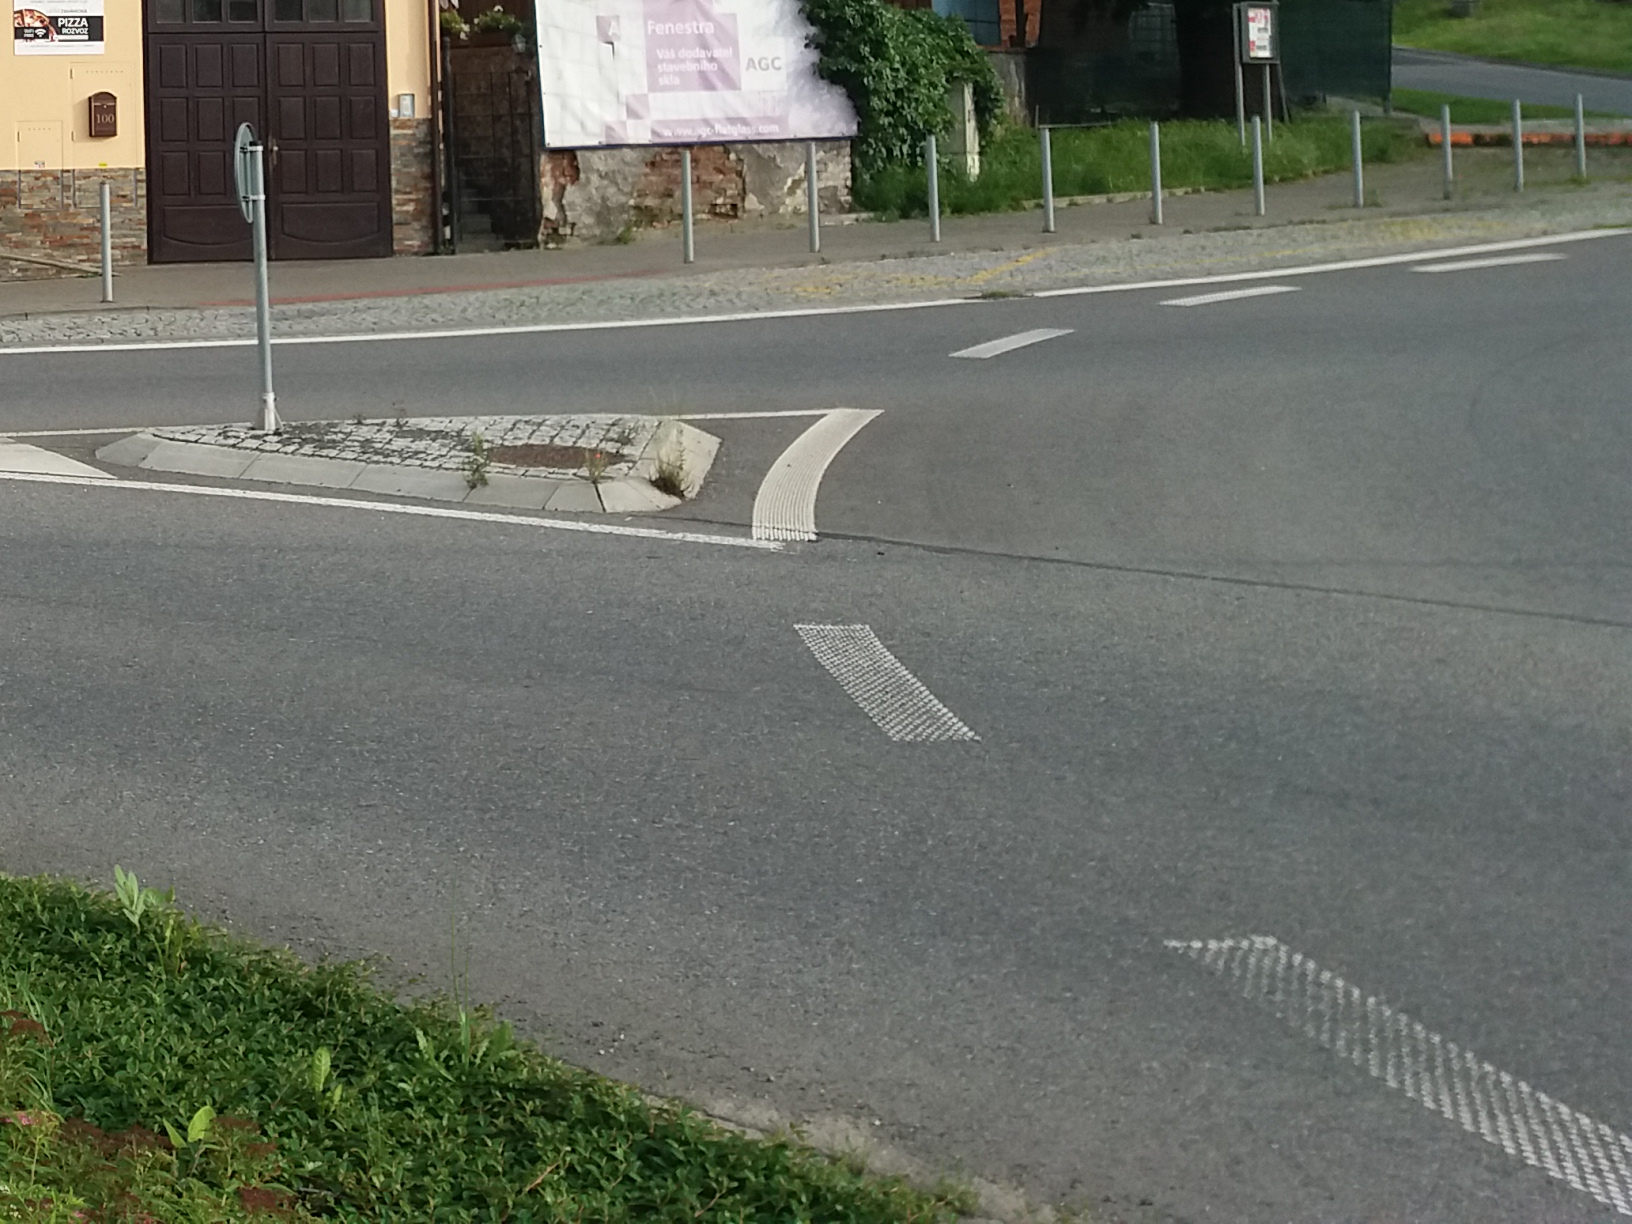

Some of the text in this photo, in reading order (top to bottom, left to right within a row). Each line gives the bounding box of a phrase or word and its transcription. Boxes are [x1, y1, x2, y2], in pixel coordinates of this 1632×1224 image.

[57, 17, 89, 28] PIZZA
[646, 19, 715, 36] Fenestra
[61, 27, 89, 35] ROZVOZ
[656, 46, 733, 60] Váš dodavatel
[657, 60, 718, 73] stavebního
[745, 56, 782, 72] AGC
[658, 75, 681, 86] skla
[96, 114, 115, 124] 100
